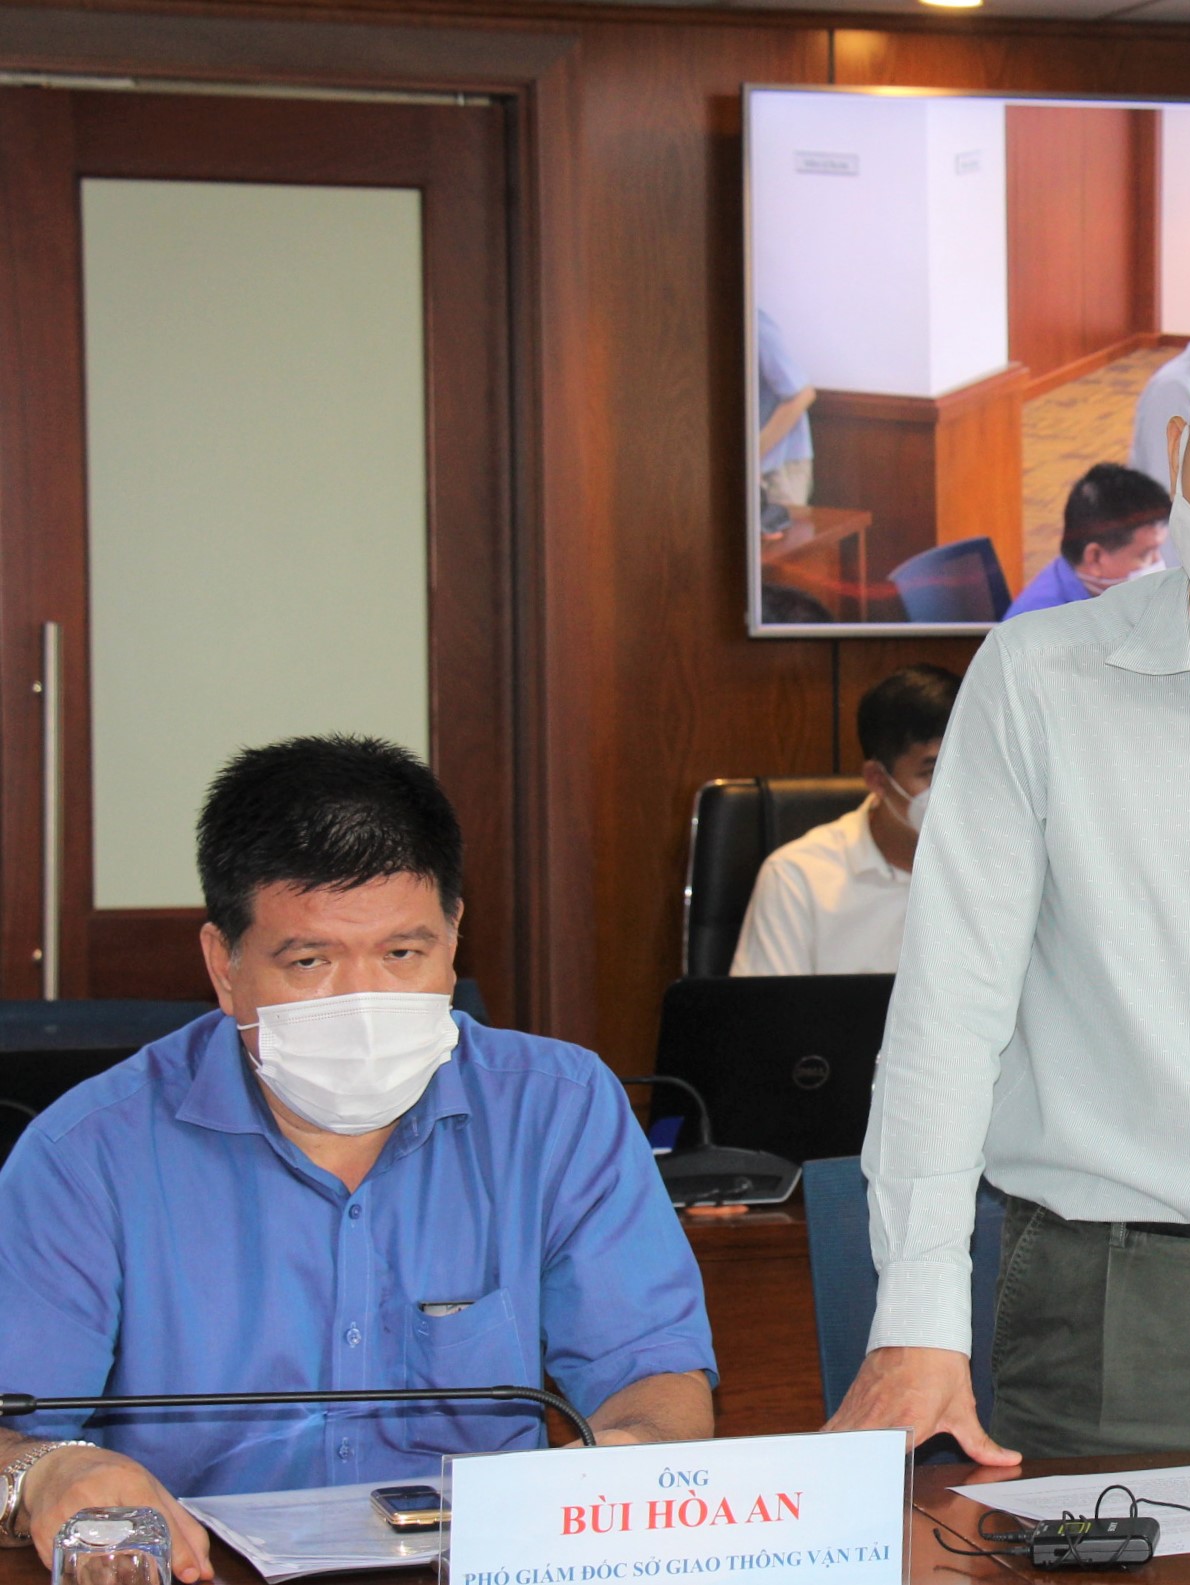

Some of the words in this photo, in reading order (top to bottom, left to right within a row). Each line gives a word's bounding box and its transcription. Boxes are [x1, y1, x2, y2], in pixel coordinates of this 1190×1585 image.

[658, 1467, 709, 1489] ÔNG
[560, 1495, 633, 1535] BÙI
[645, 1489, 737, 1530] HÒA
[744, 1491, 803, 1523] AN
[464, 1565, 510, 1585] PHÓ
[515, 1563, 575, 1584] GIÁM
[581, 1559, 627, 1580] ĐỐC
[632, 1556, 661, 1577] SỞ
[666, 1556, 721, 1574] GIAO
[726, 1549, 801, 1570] THÔNG
[807, 1546, 849, 1568] VẬN
[855, 1541, 890, 1562] TẢI
